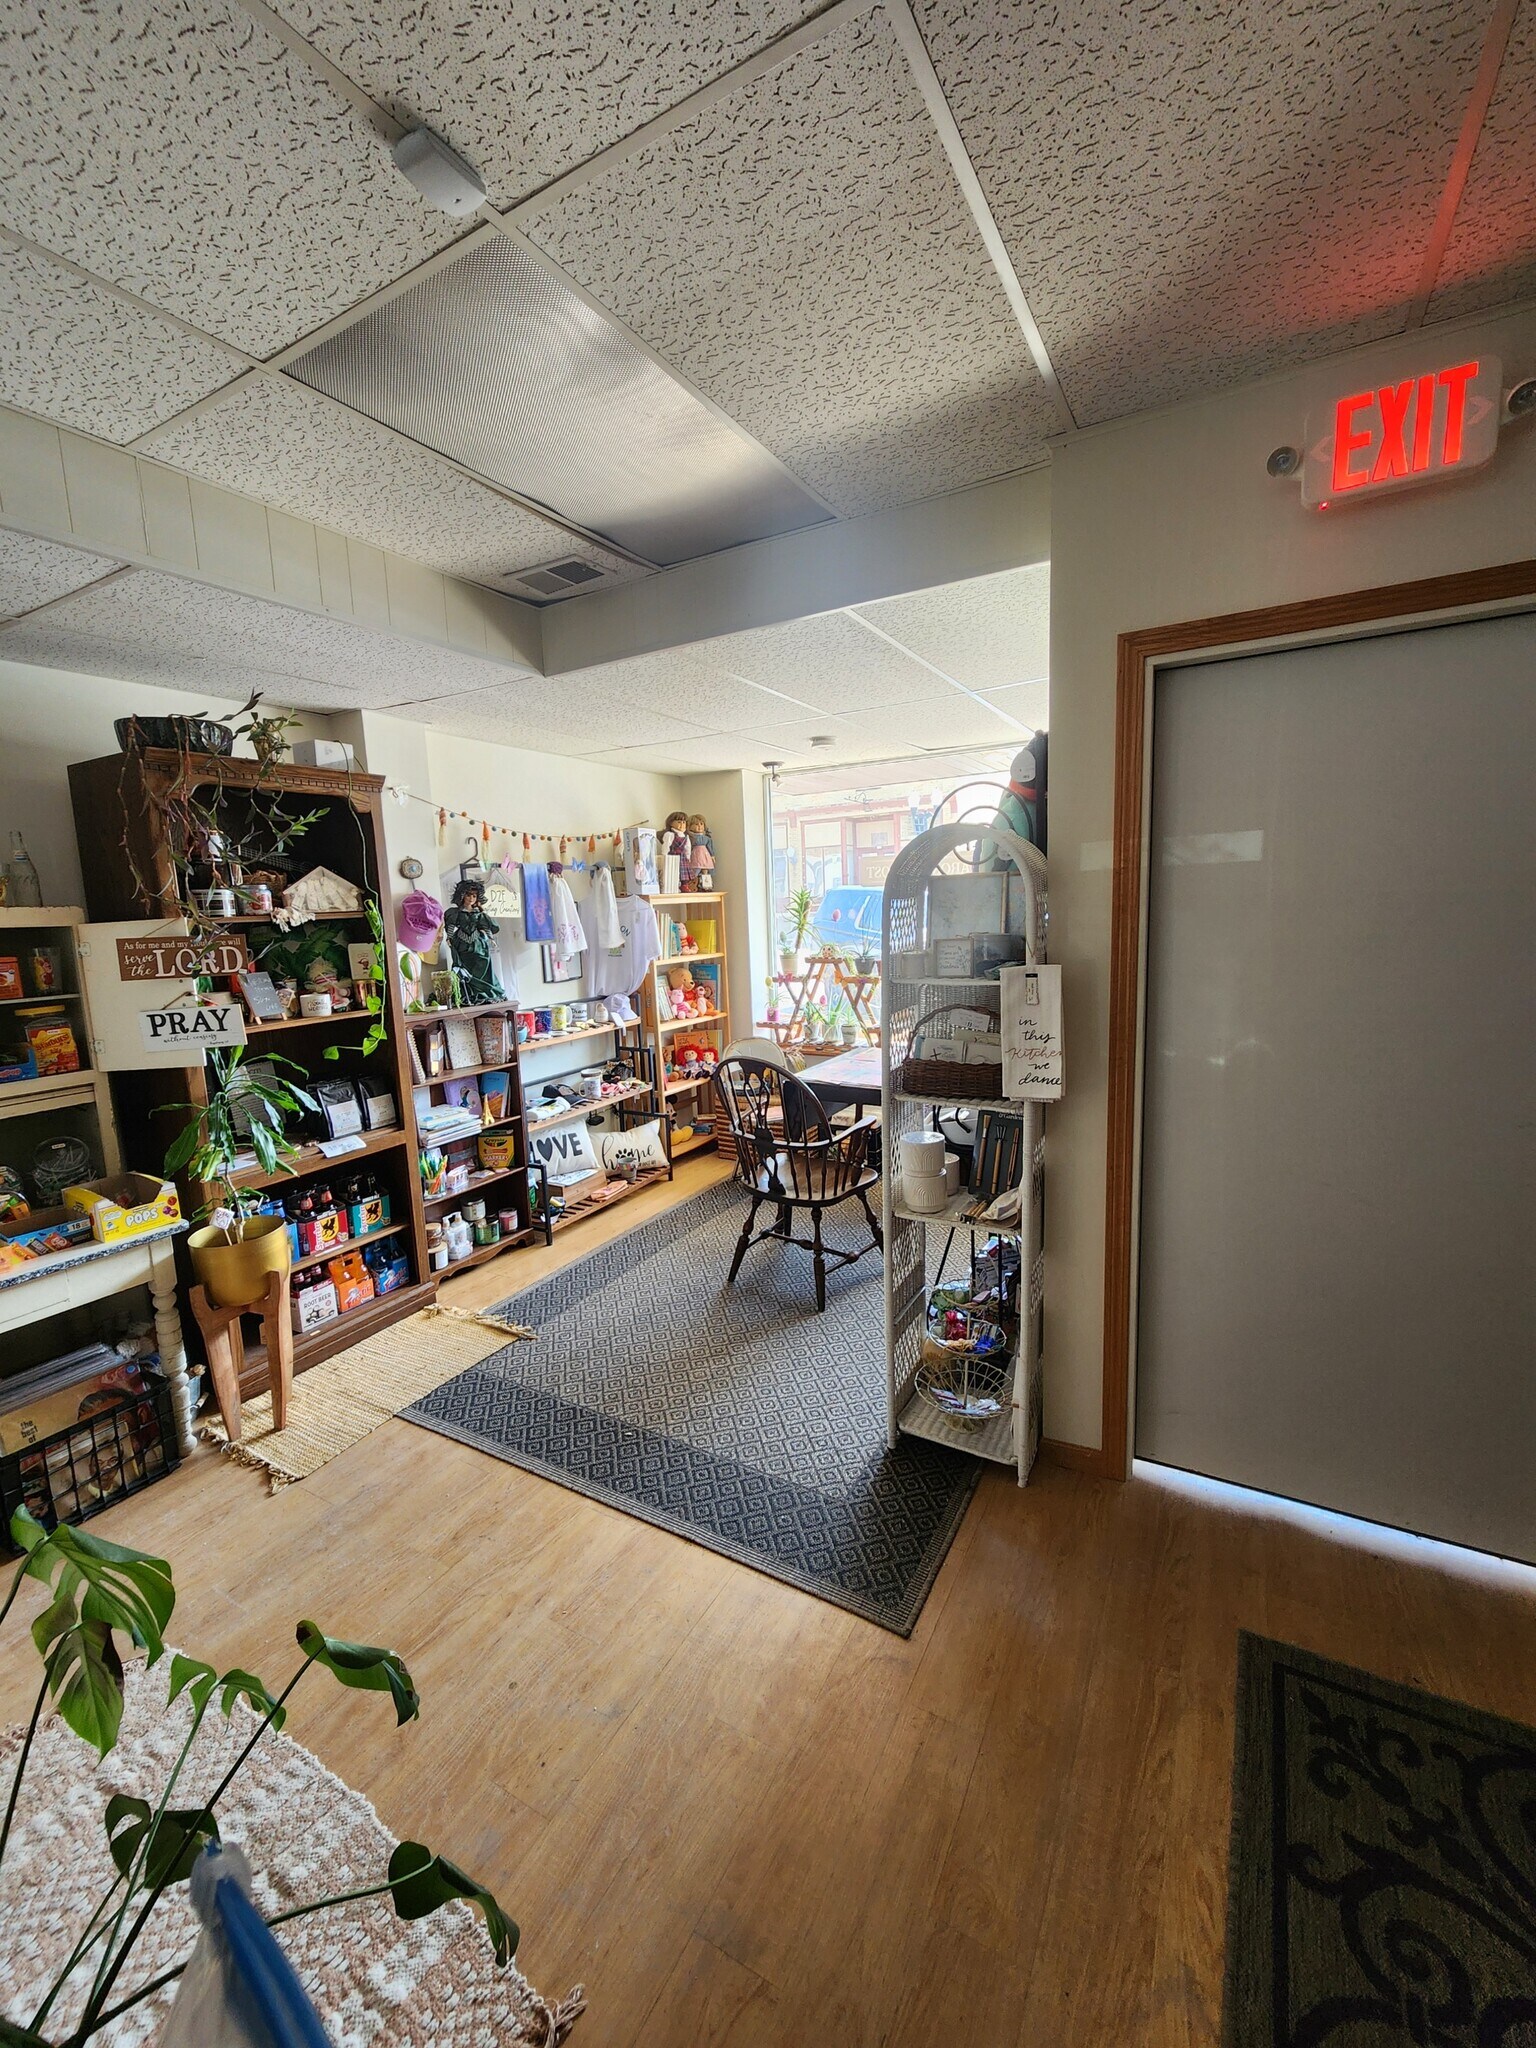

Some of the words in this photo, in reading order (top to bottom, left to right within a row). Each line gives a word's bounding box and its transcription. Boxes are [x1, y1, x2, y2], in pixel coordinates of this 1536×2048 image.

[1332, 361, 1480, 492] EXIT
[124, 942, 134, 950] As
[135, 941, 146, 949] for
[177, 941, 188, 949] my
[228, 937, 241, 946] will
[124, 952, 156, 965] serve
[153, 945, 244, 977] LORD
[126, 964, 154, 977] the
[146, 1008, 231, 1037] PRAY
[1018, 1016, 1038, 1026] in
[163, 1034, 191, 1043] without
[1022, 1030, 1056, 1044] this
[1028, 1062, 1050, 1070] we
[1018, 1072, 1063, 1086] dance
[125, 1208, 159, 1227] POPS
[71, 1222, 81, 1230] 18
[303, 1298, 318, 1309] ROOT
[318, 1293, 332, 1303] BEER
[20, 1419, 34, 1431] the
[20, 1426, 39, 1438] best
[28, 1433, 37, 1445] of
